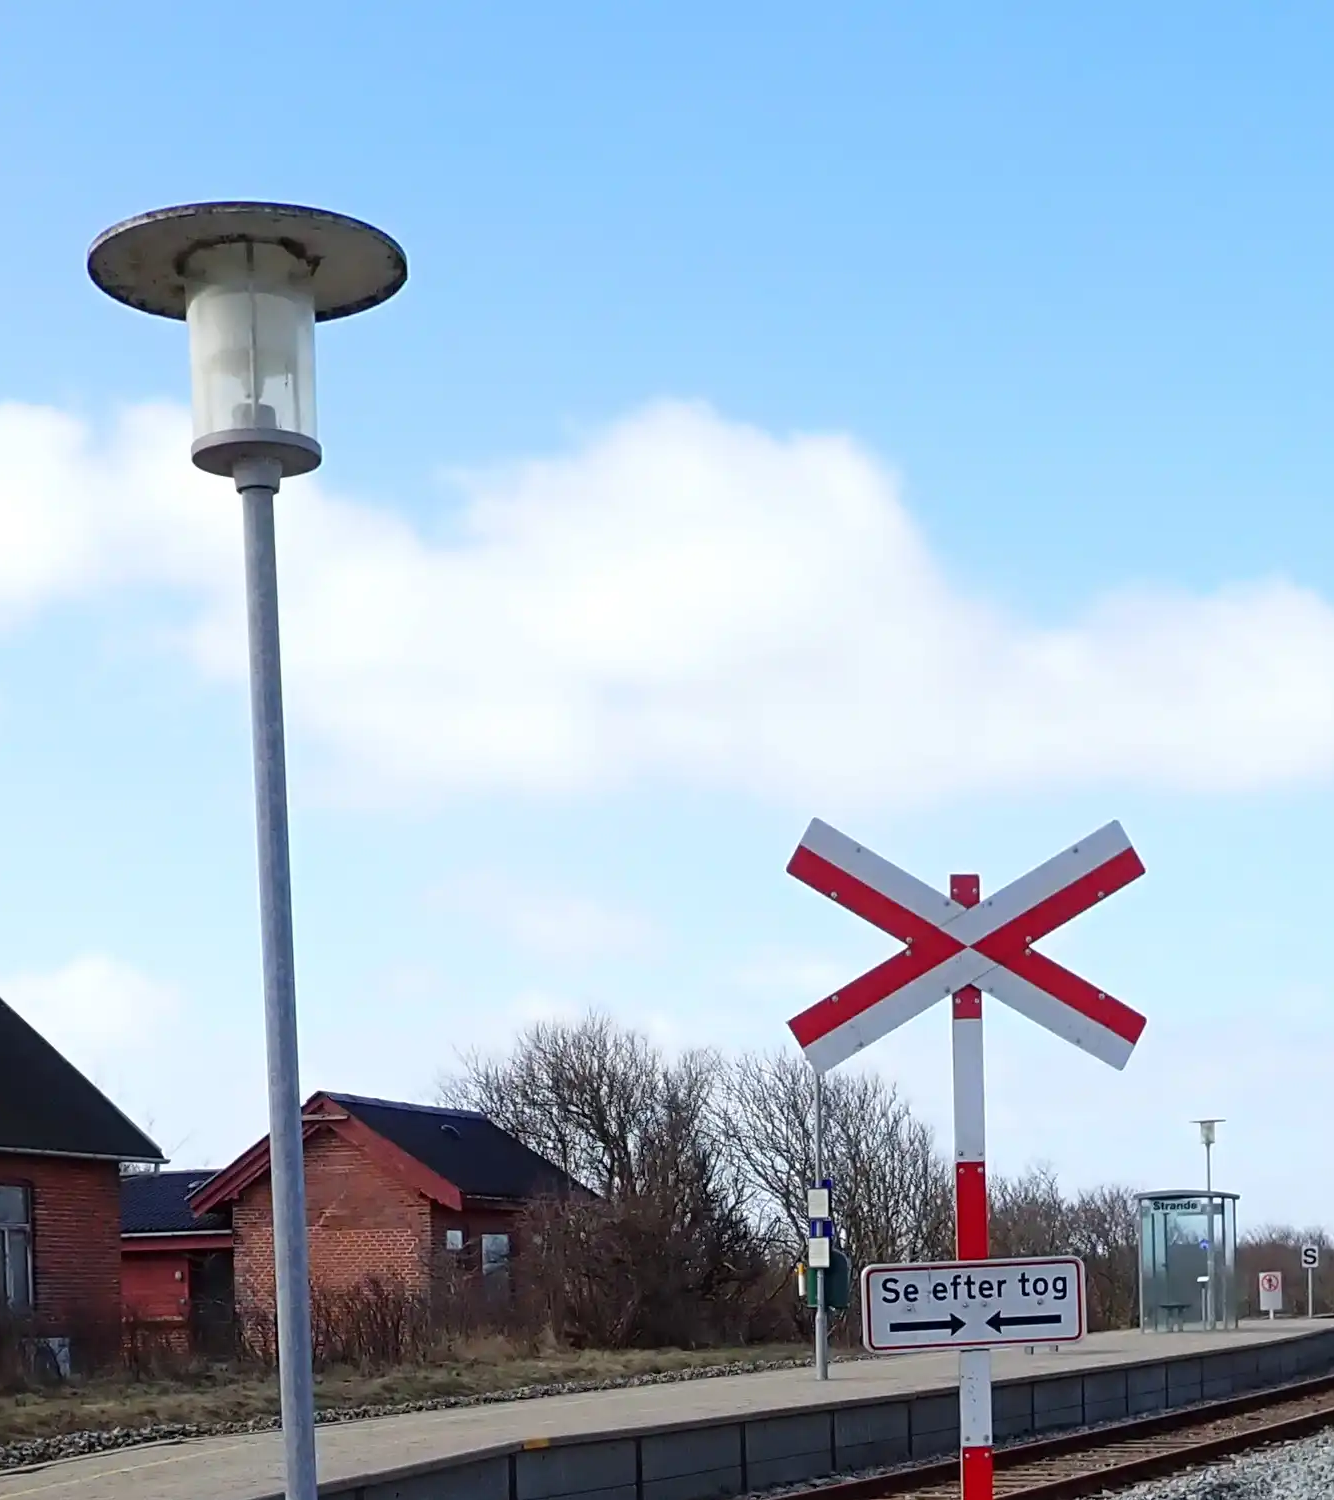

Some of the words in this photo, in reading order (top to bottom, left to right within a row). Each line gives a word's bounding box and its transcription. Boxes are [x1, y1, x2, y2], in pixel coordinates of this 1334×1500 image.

[1303, 1248, 1317, 1265] S
[881, 1278, 919, 1304] Se
[932, 1274, 1007, 1301] efter
[1019, 1272, 1068, 1301] tog
